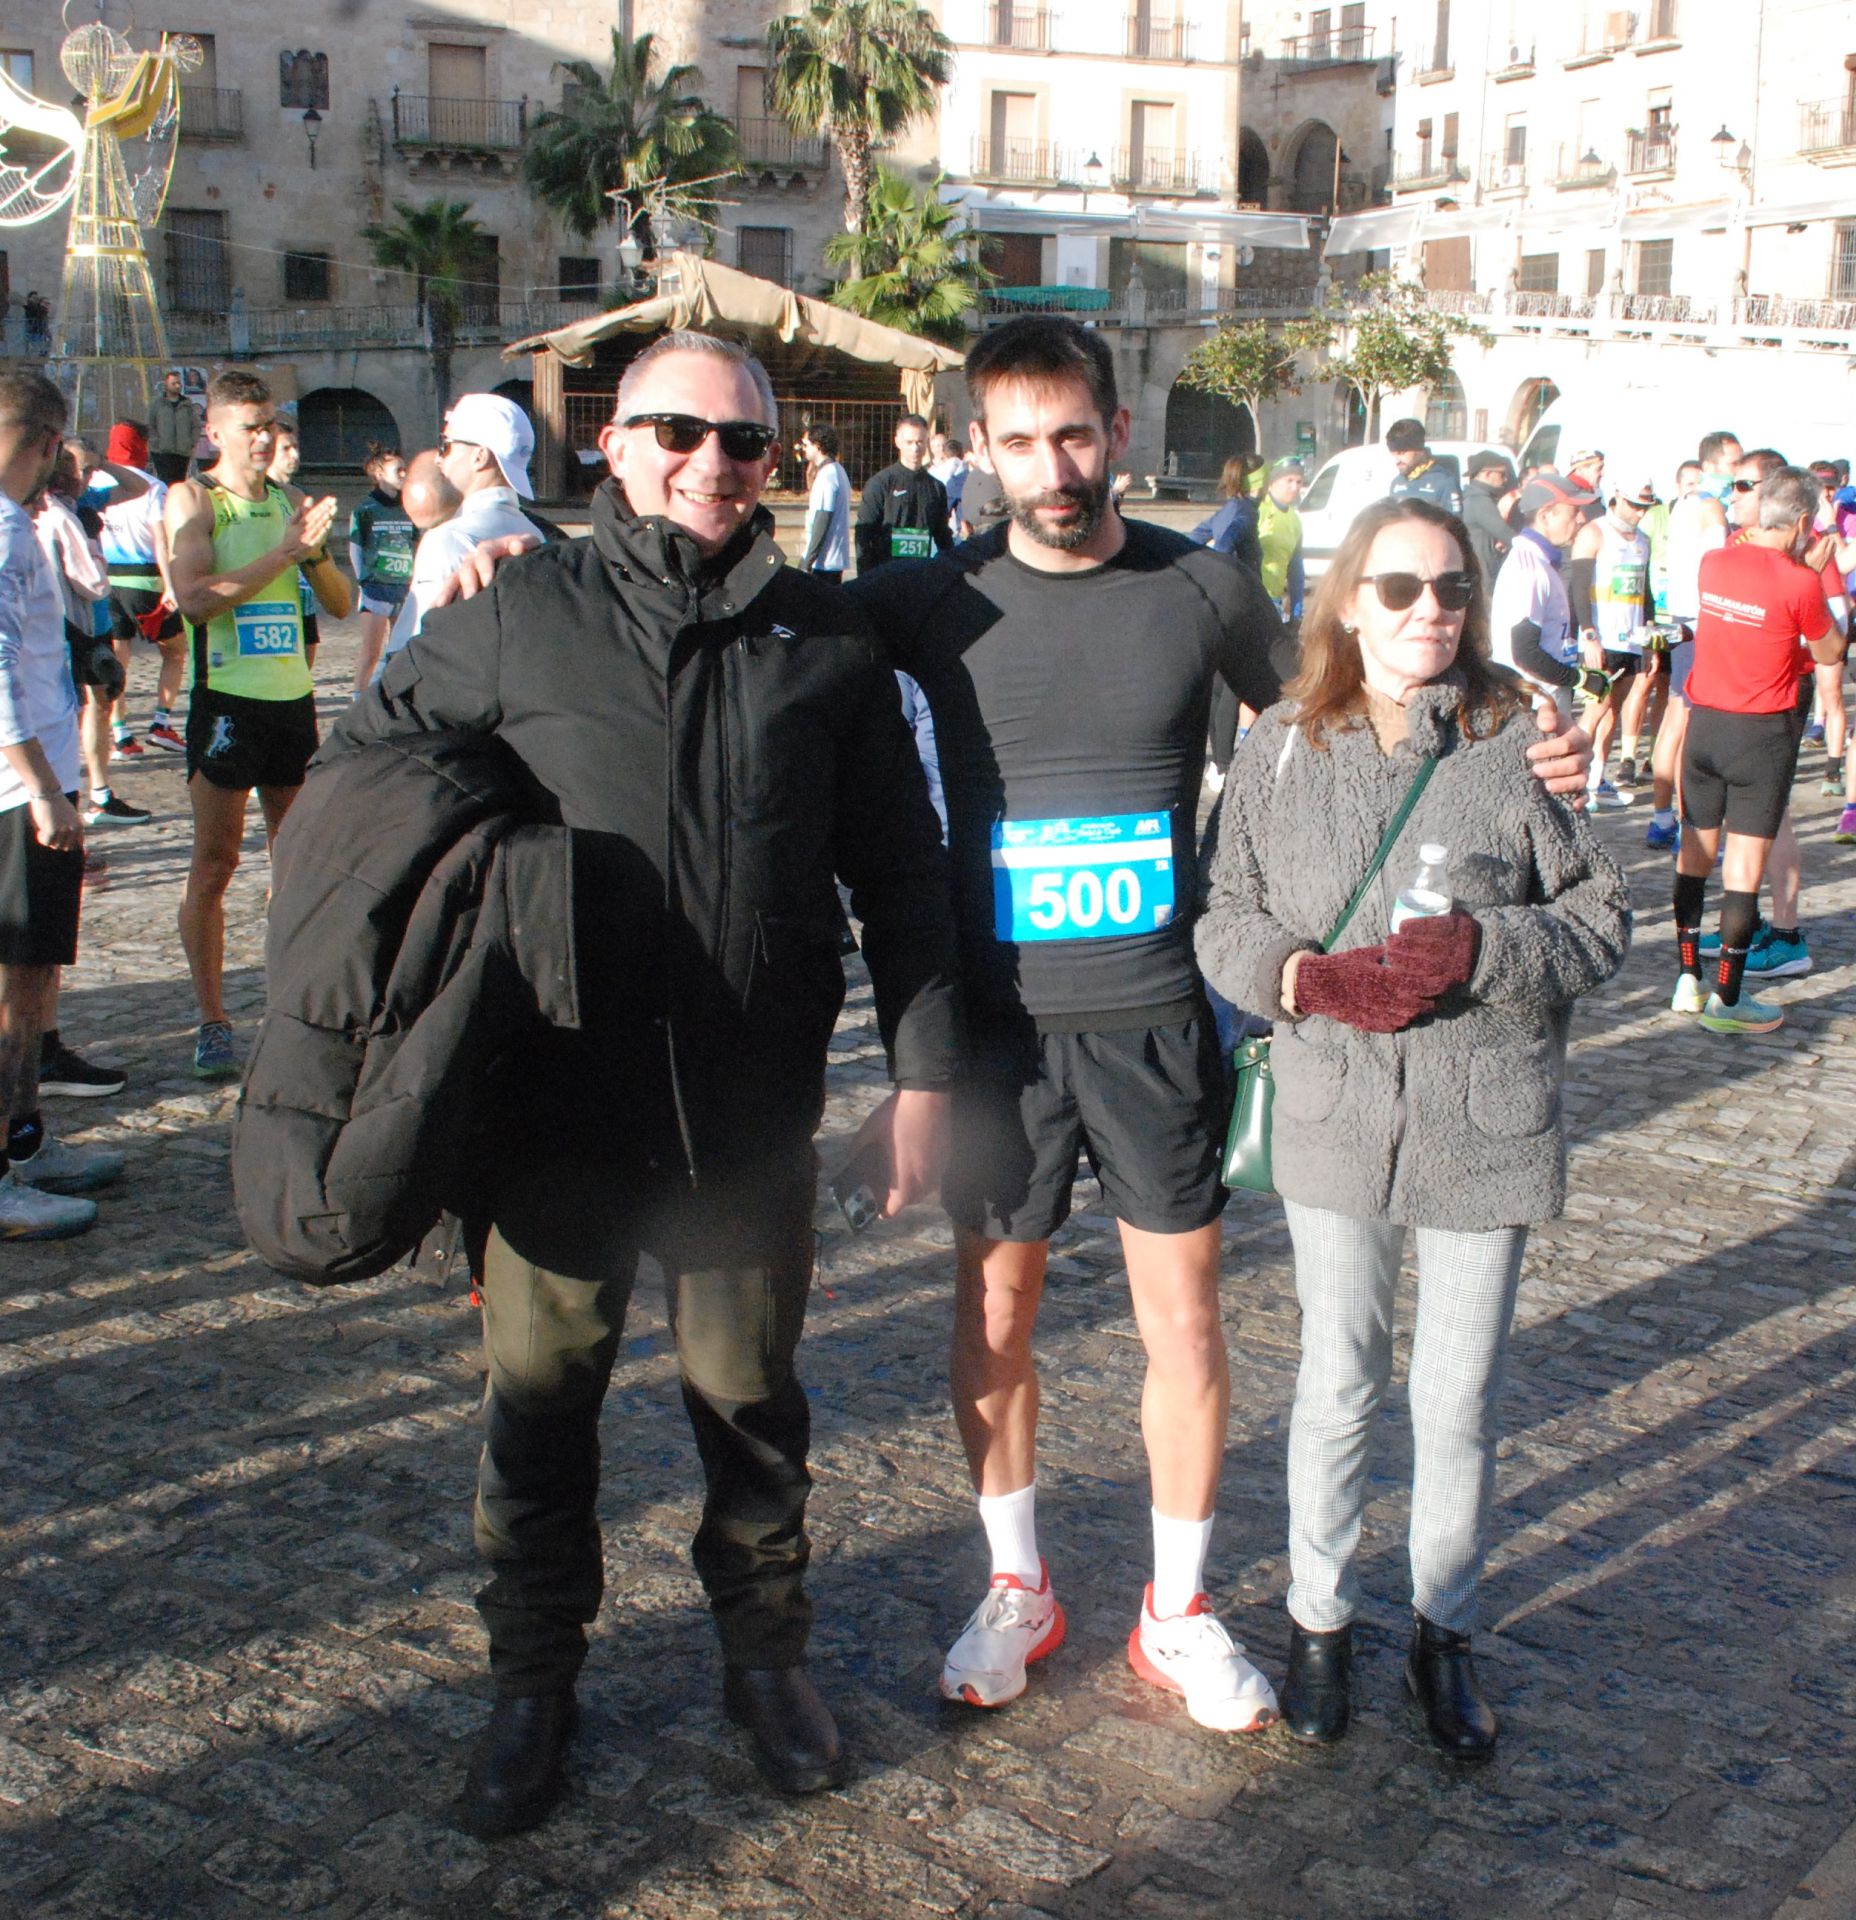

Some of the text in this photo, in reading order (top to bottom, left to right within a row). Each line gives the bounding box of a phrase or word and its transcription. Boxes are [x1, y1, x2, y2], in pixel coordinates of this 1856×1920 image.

[899, 540, 922, 555] 251
[384, 558, 409, 573] 208
[254, 625, 293, 650] 582
[1029, 868, 1142, 930] 500
